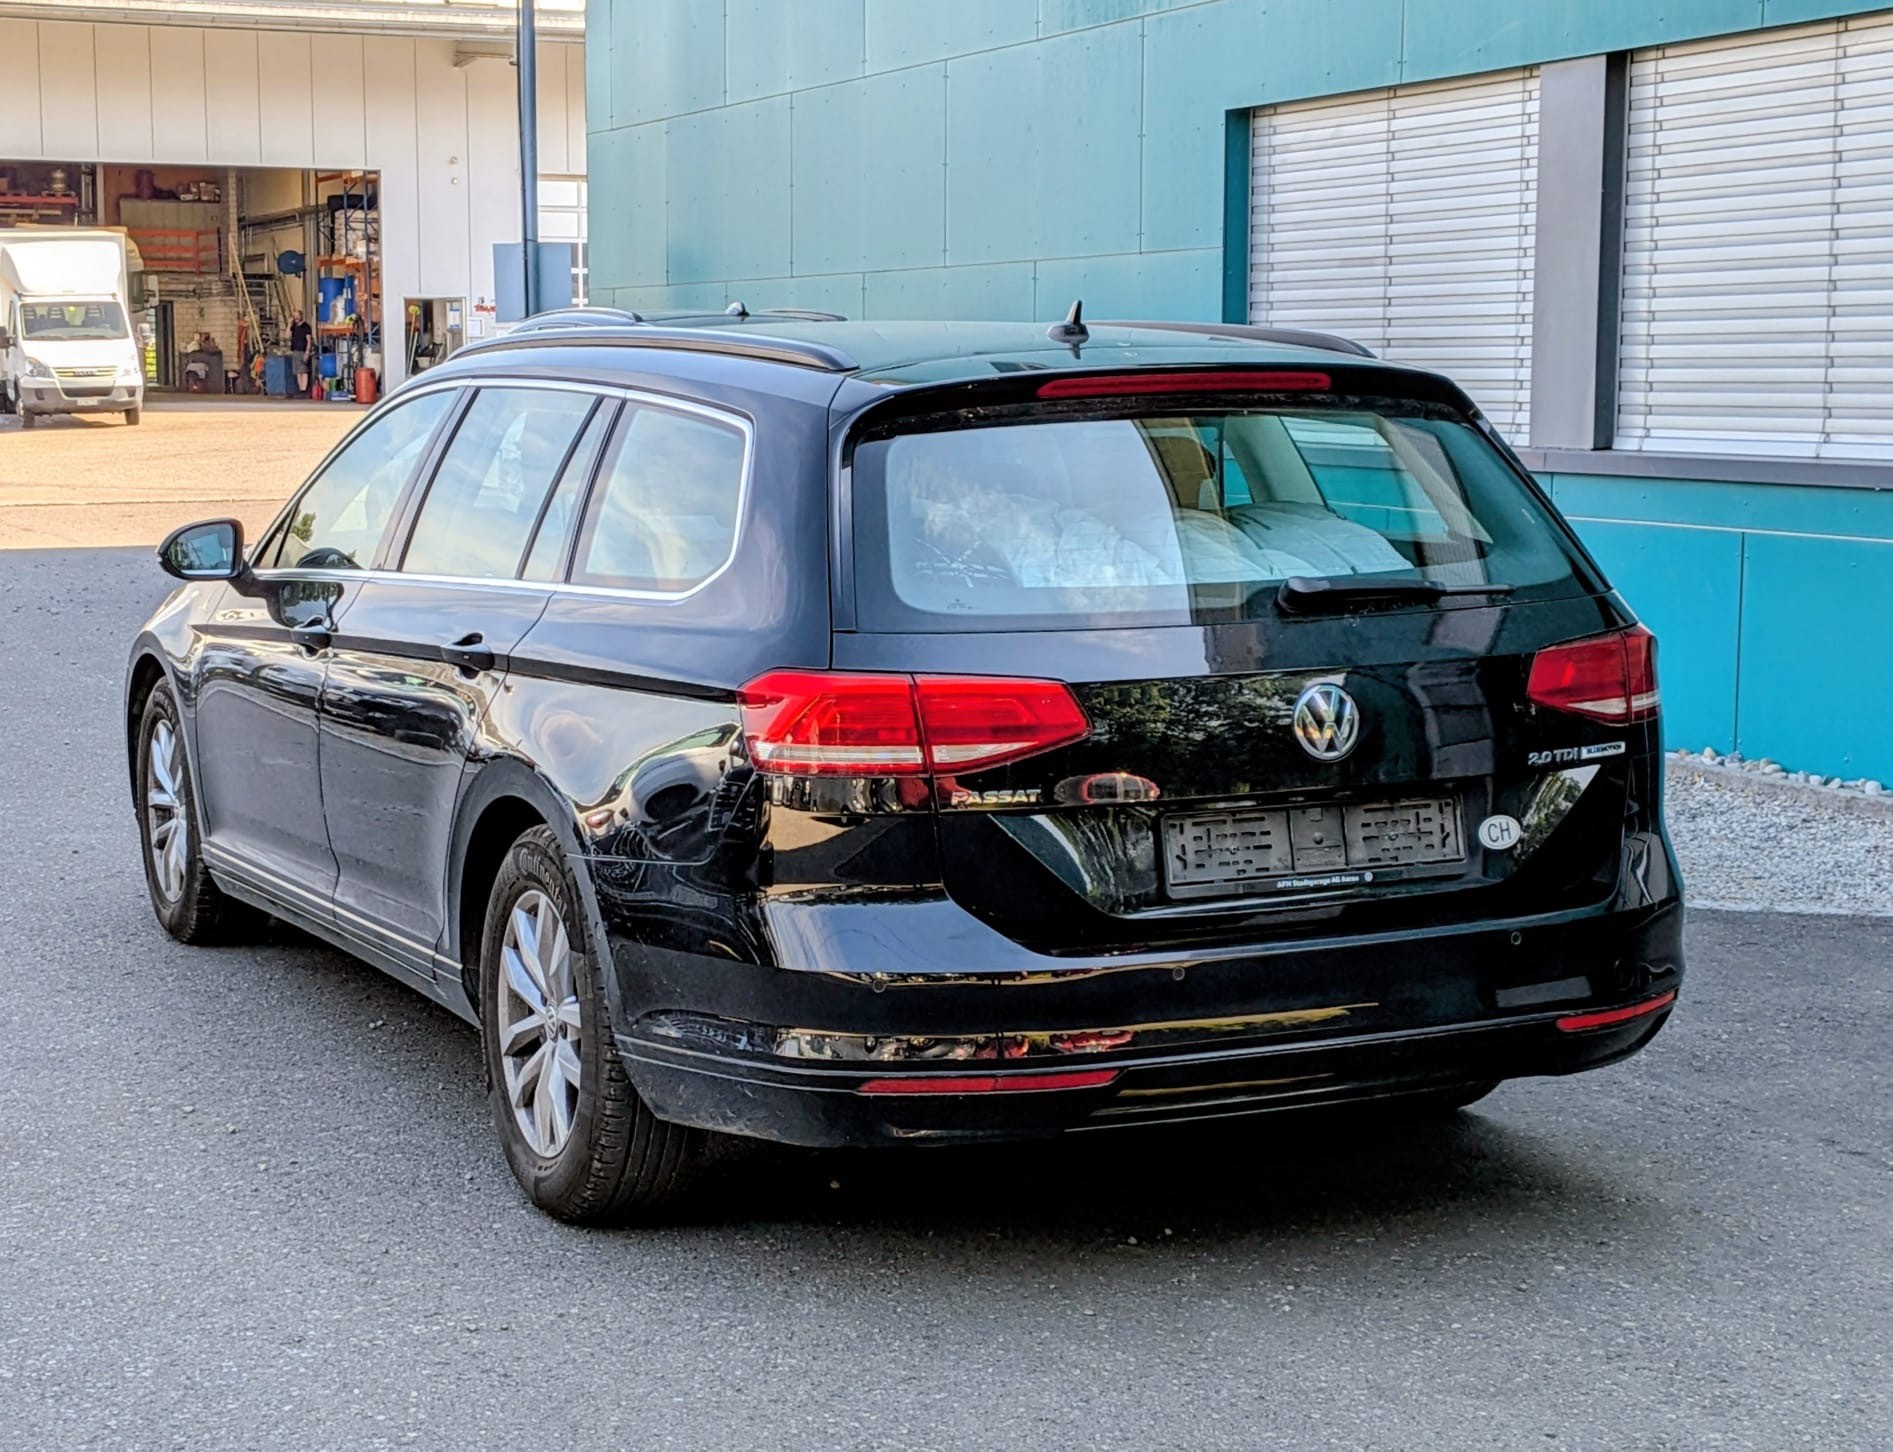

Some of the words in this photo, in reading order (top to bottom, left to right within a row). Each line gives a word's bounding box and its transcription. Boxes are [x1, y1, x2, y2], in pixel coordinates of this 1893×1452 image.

[1295, 685, 1359, 760] VW
[1553, 747, 1579, 761] TDI
[951, 789, 1041, 805] PASSAT
[1487, 820, 1511, 843] CH
[519, 847, 568, 918] Continental
